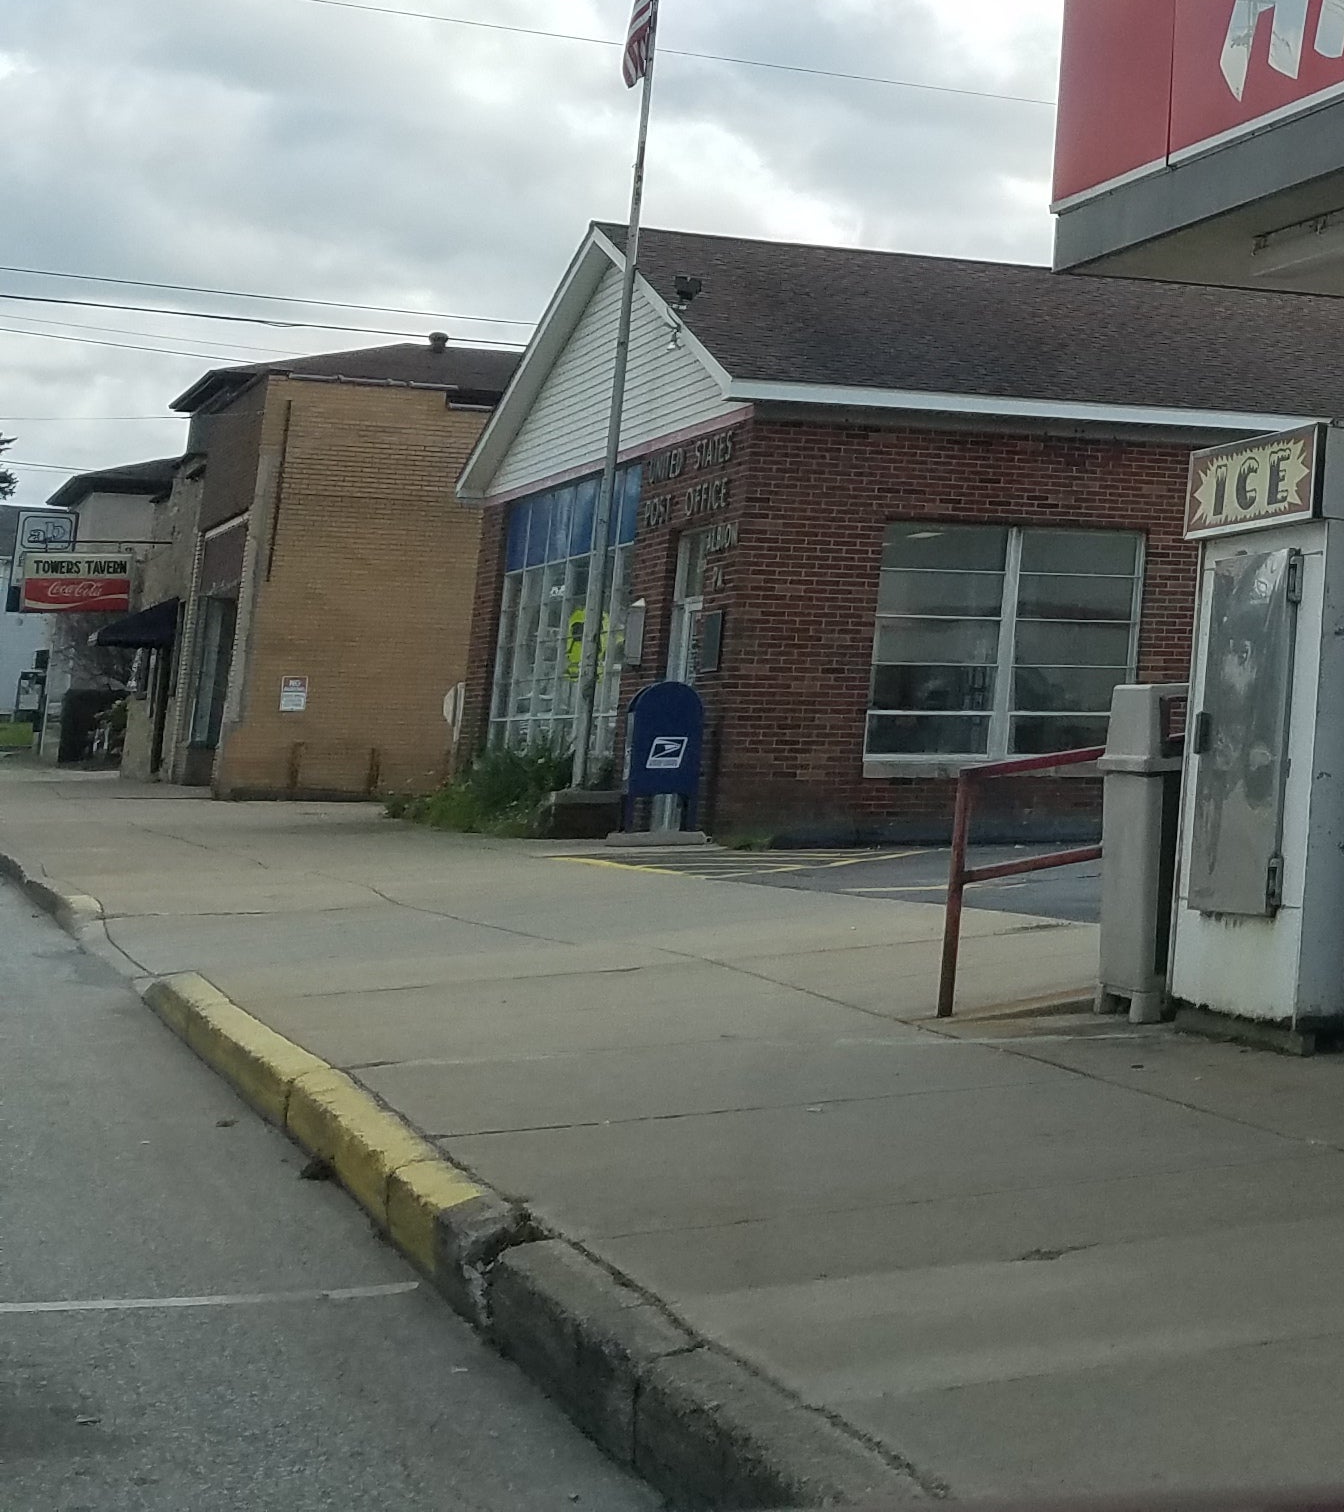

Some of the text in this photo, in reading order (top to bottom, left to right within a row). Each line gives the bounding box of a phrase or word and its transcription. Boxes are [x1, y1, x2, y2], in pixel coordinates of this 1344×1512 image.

[650, 430, 733, 483] UNITED STATES
[645, 477, 728, 527] POST OFFICE
[1212, 447, 1291, 518] ICE
[34, 560, 81, 575] TOWERS
[85, 560, 127, 575] TAVERN
